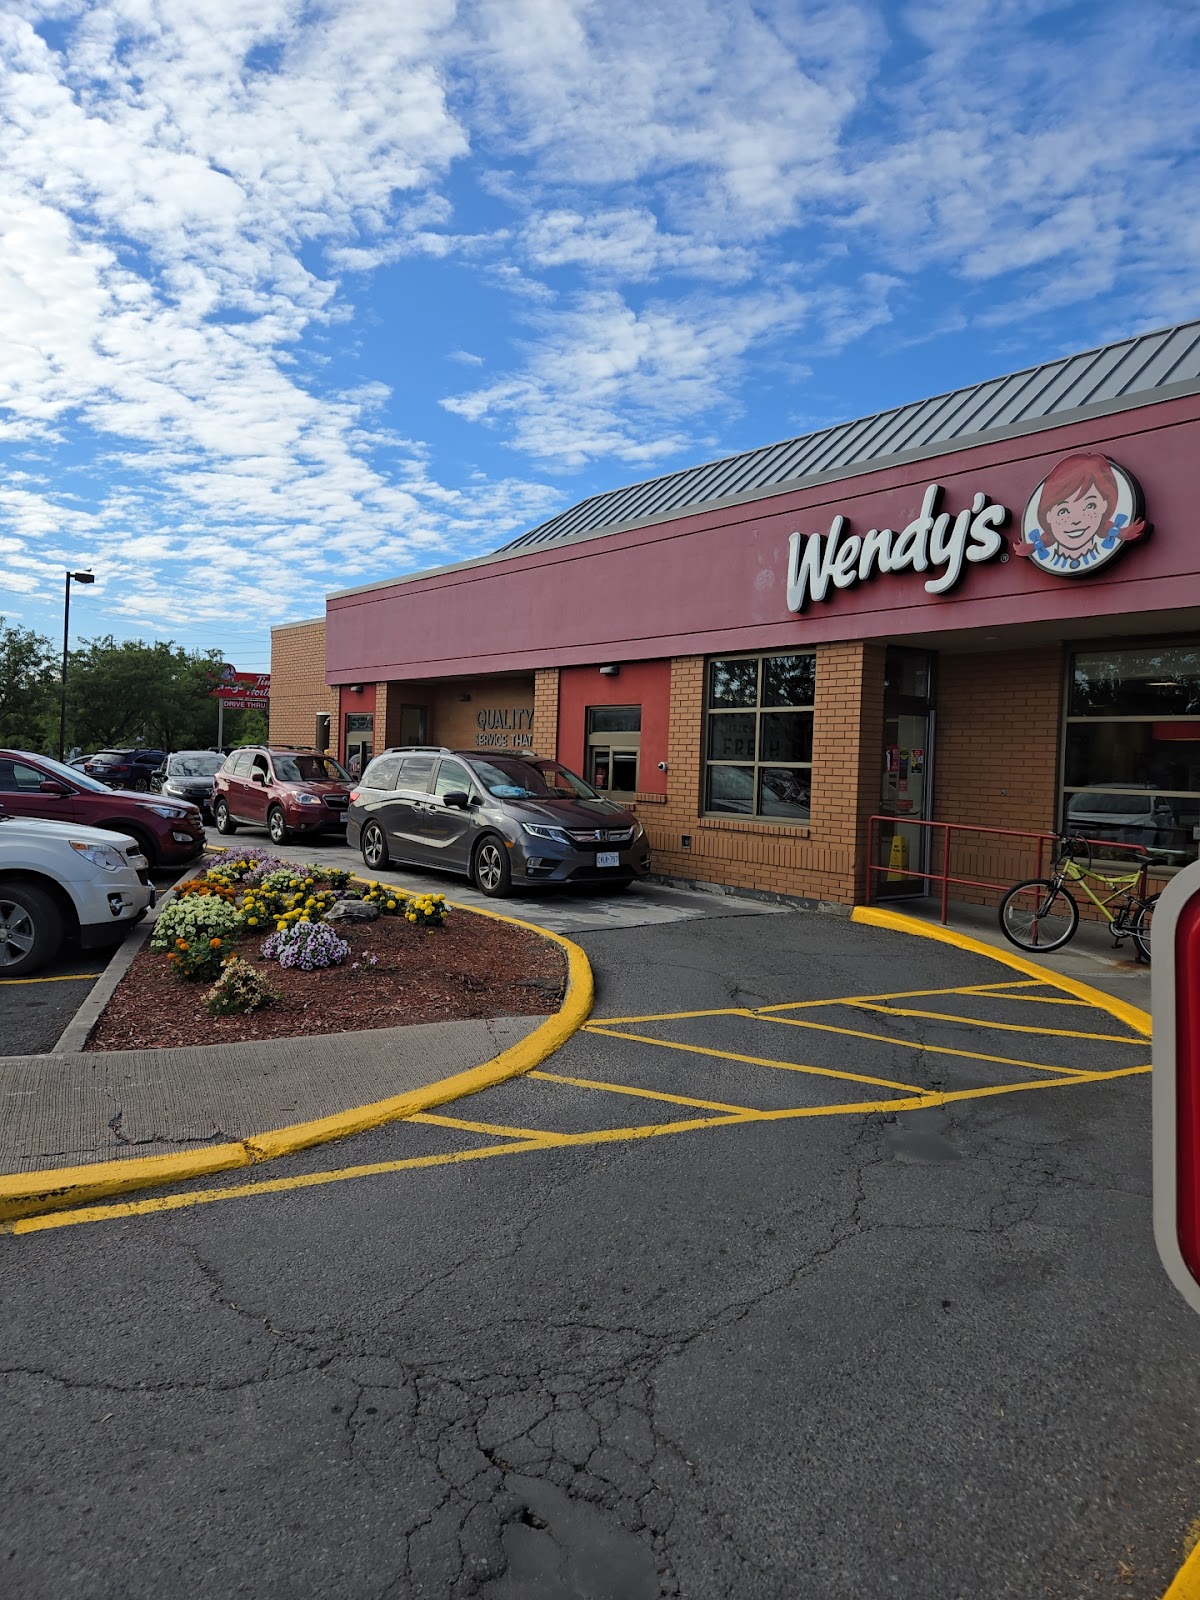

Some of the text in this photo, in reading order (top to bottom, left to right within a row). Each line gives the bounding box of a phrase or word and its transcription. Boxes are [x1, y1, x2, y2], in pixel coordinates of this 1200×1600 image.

[785, 483, 1006, 613] Wendy's
[224, 700, 266, 709] DRIVE THRU
[477, 708, 535, 731] QUALITY
[476, 733, 533, 747] SERVICE THAT
